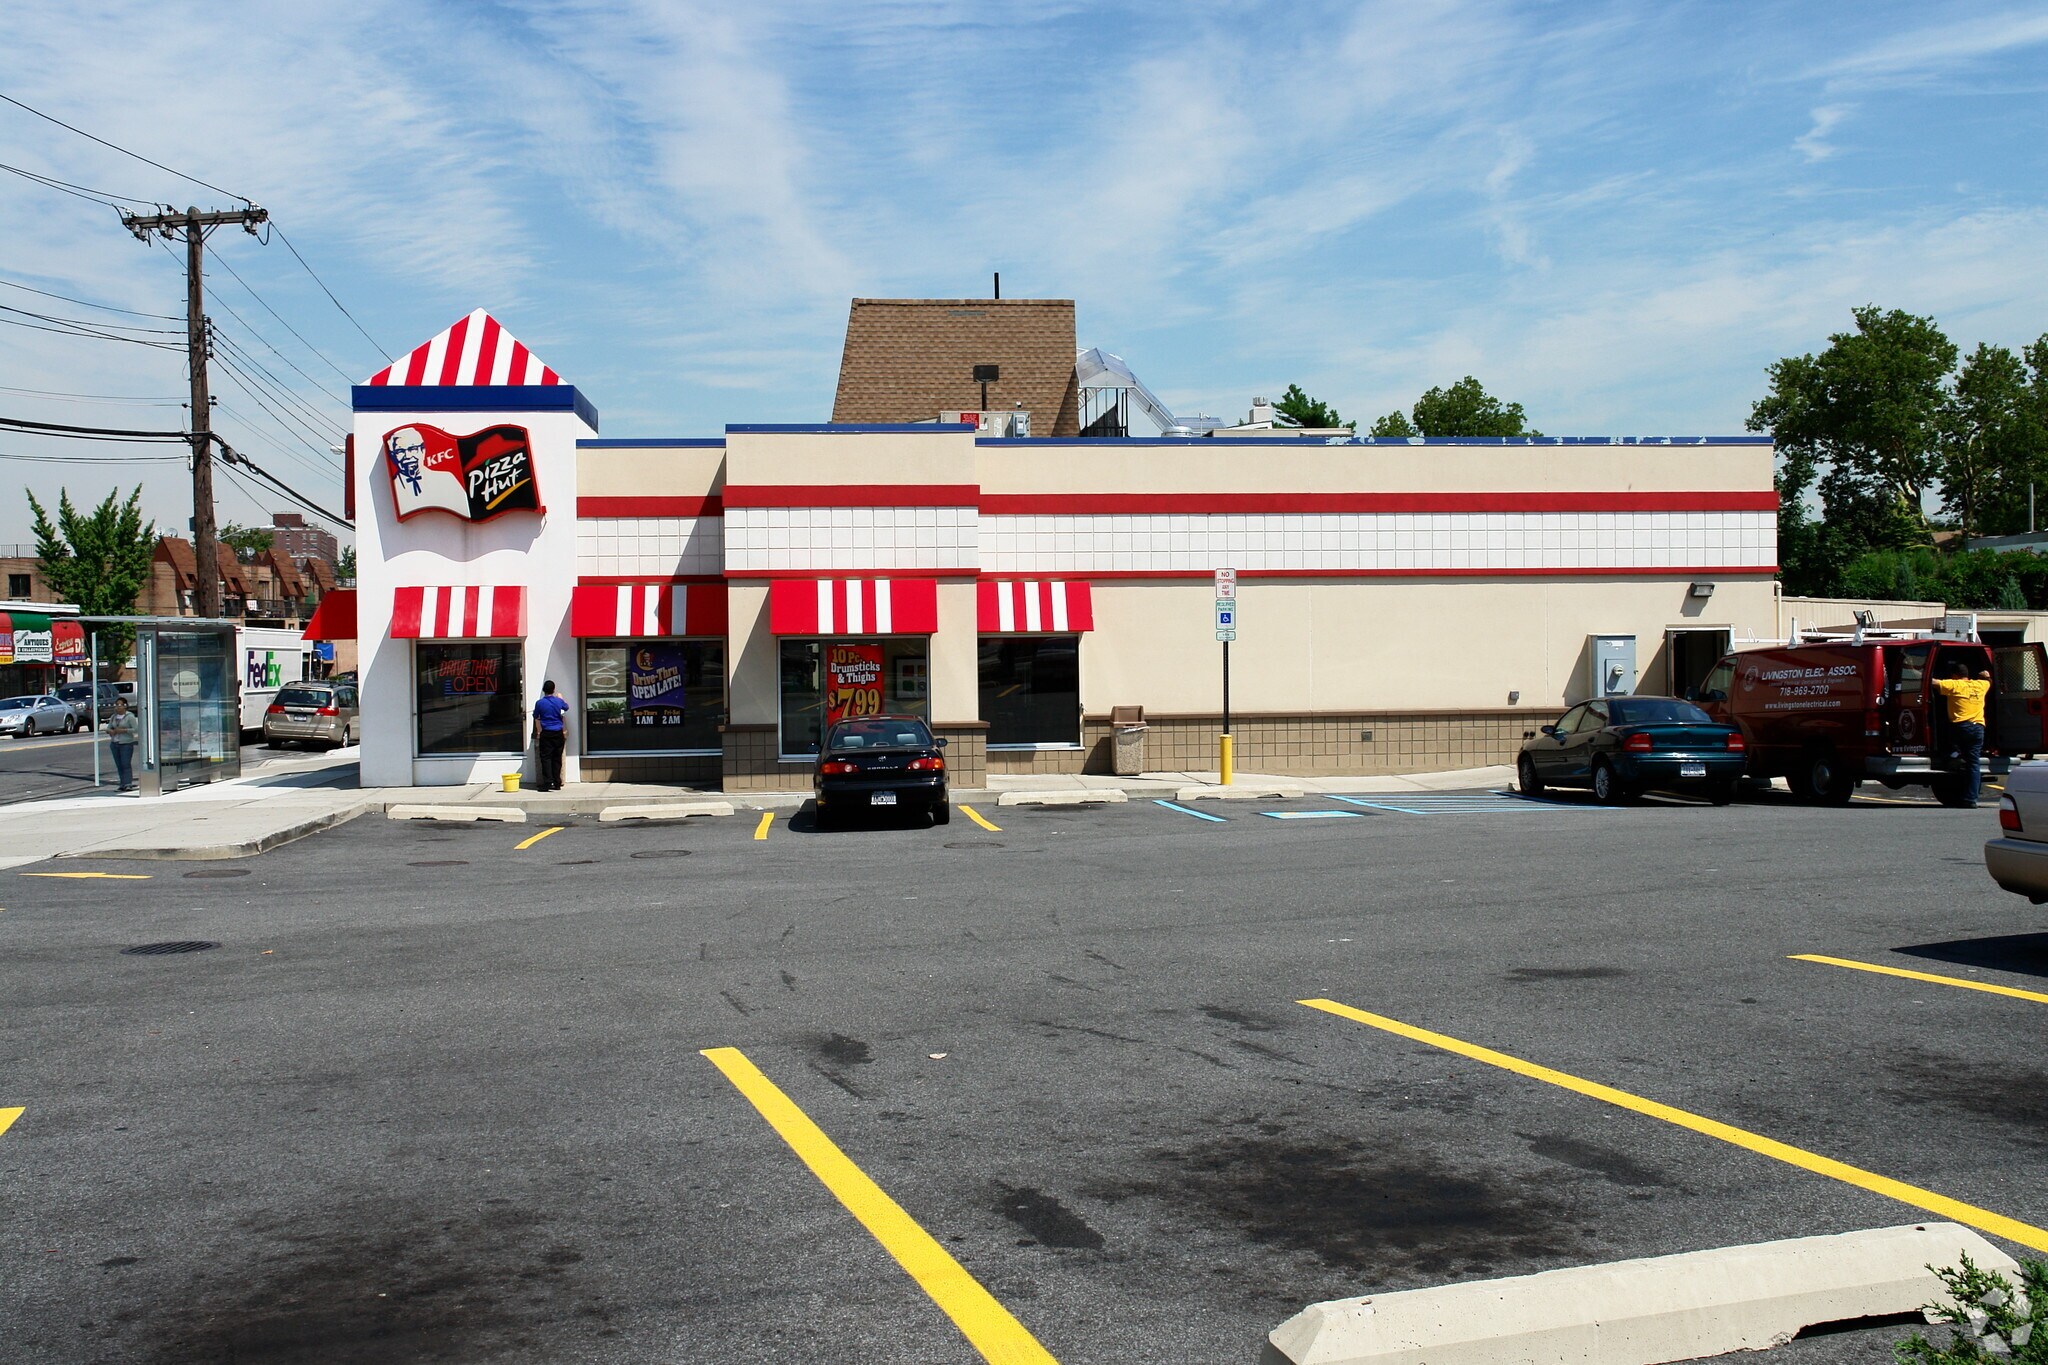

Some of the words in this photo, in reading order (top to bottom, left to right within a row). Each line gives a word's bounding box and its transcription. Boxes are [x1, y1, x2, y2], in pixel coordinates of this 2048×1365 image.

[427, 449, 454, 467] KFC
[469, 451, 526, 499] Pizza
[481, 468, 523, 502] Hut
[24, 638, 49, 646] ANTIQUES
[832, 648, 847, 664] 10
[849, 651, 863, 664] Pc.
[247, 651, 281, 688] FedEx
[437, 659, 469, 677] DRIVE
[471, 659, 497, 675] THRU
[830, 661, 881, 673] Drumsticks
[1761, 669, 1803, 680] LIVINGSTON
[1804, 667, 1825, 678] ELEC.
[1827, 665, 1857, 677] ASSOC.
[632, 665, 678, 686] Drive-Thru
[837, 673, 845, 684] &
[846, 671, 876, 685] Thighs
[453, 676, 498, 692] OPEN
[632, 683, 657, 699] OPEN
[656, 674, 682, 693] LATE!
[1780, 685, 1830, 697] 718-969-2700
[1765, 700, 1841, 710] www.livingstonelectrical.com
[636, 715, 640, 725] 1
[641, 715, 654, 725] AM
[662, 715, 667, 725] 2
[668, 715, 681, 725] AM
